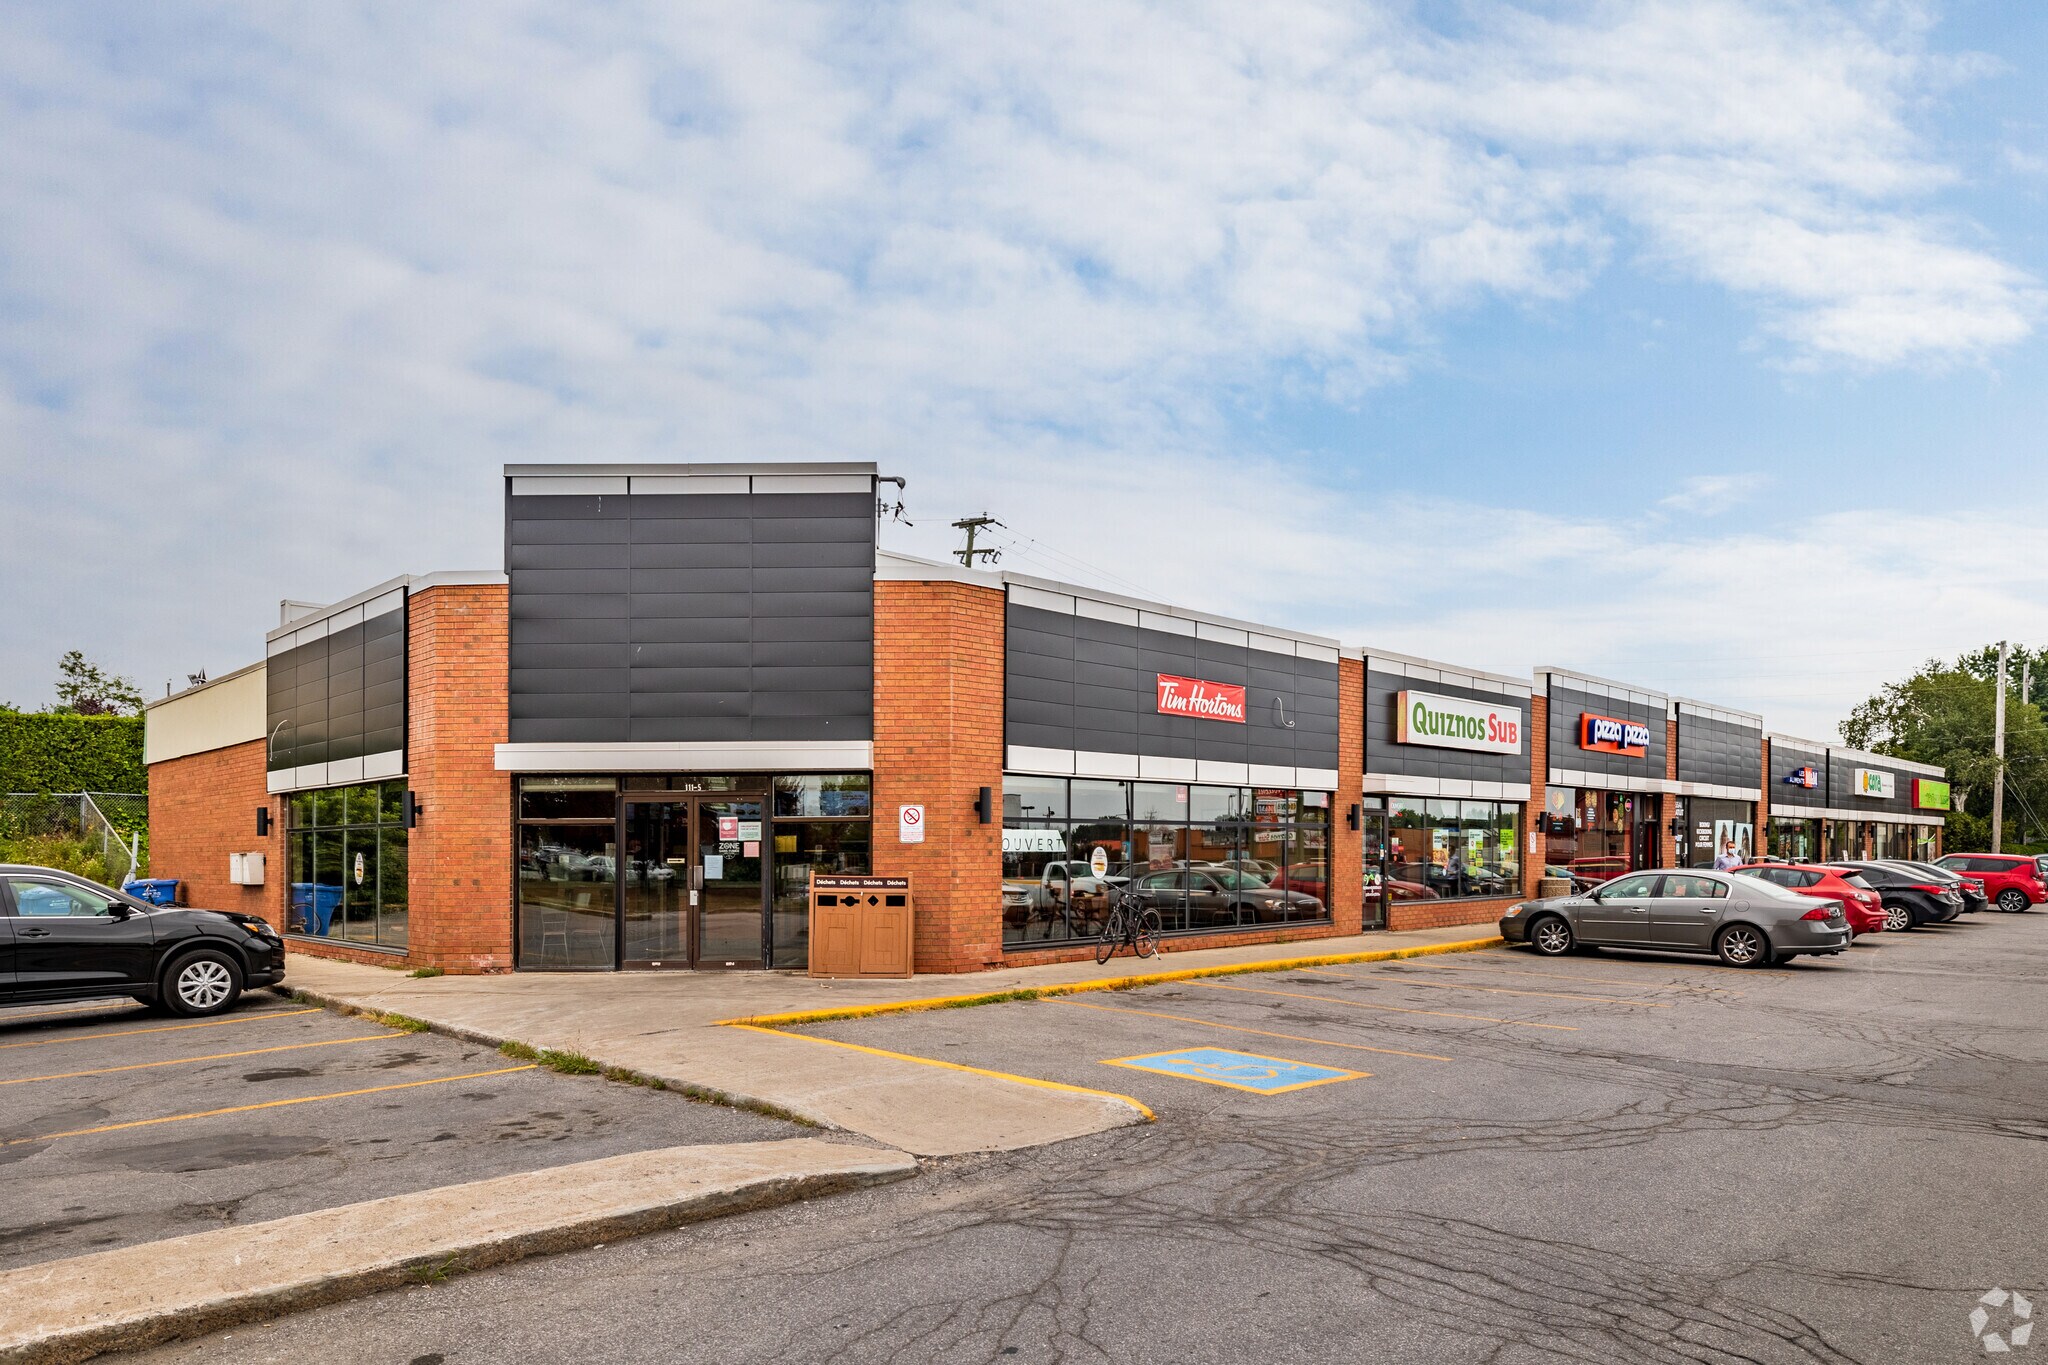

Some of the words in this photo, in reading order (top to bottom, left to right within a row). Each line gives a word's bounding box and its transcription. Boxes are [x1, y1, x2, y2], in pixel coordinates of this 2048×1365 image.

[1160, 681, 1187, 711] Tim
[1188, 683, 1243, 718] Hortons
[1593, 718, 1622, 744] pizza
[1624, 723, 1650, 749] pizza
[718, 842, 740, 850] ZONE
[1002, 837, 1063, 851] OUVERT
